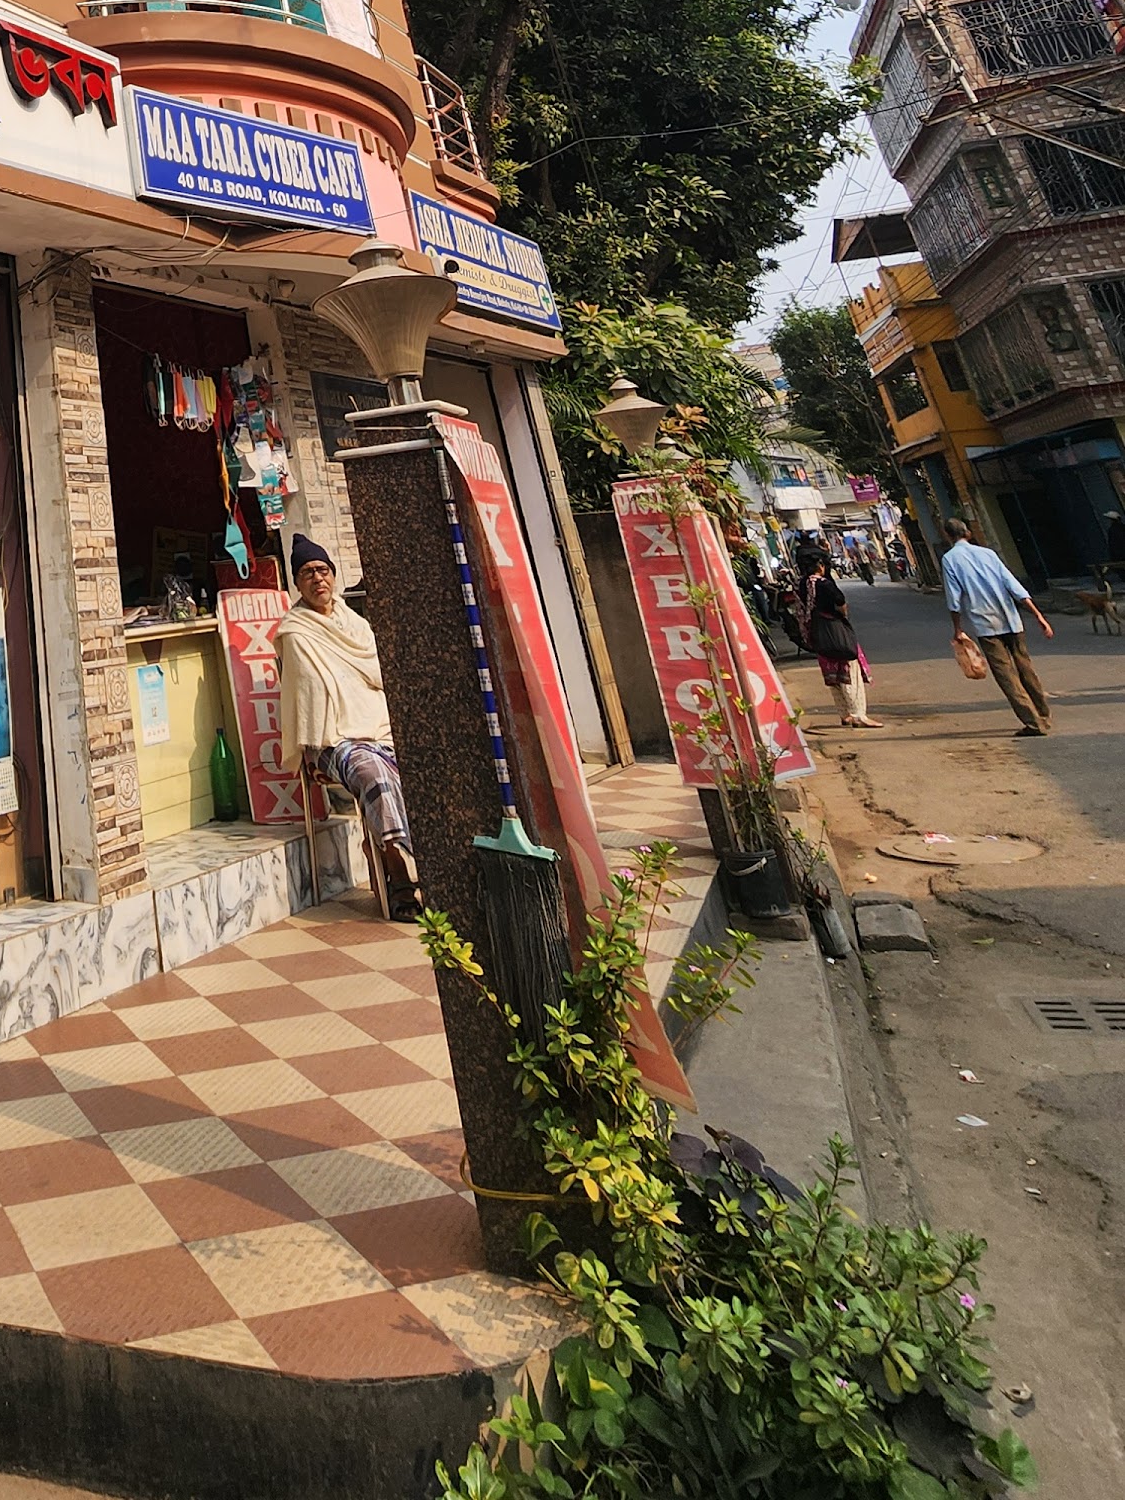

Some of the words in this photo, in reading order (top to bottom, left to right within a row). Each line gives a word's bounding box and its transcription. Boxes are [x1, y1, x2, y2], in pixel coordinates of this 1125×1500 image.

[142, 103, 198, 167] MAA
[195, 116, 257, 178] TARA
[254, 130, 317, 192] CYBER
[313, 145, 363, 202] CAFE
[177, 171, 195, 190] 40
[197, 175, 223, 195] M.B
[225, 180, 267, 206] ROAD,
[268, 189, 325, 214] KOLKATA
[332, 202, 348, 219] 60
[416, 200, 455, 252] ASHA
[449, 213, 507, 272] MEDICAL
[502, 235, 547, 285] STORES
[455, 264, 487, 284] emists
[489, 273, 498, 288] &
[499, 277, 538, 300] Druggist
[226, 591, 286, 622] DIGITAL
[634, 522, 733, 770] XEROX
[235, 620, 306, 819] XEROX
